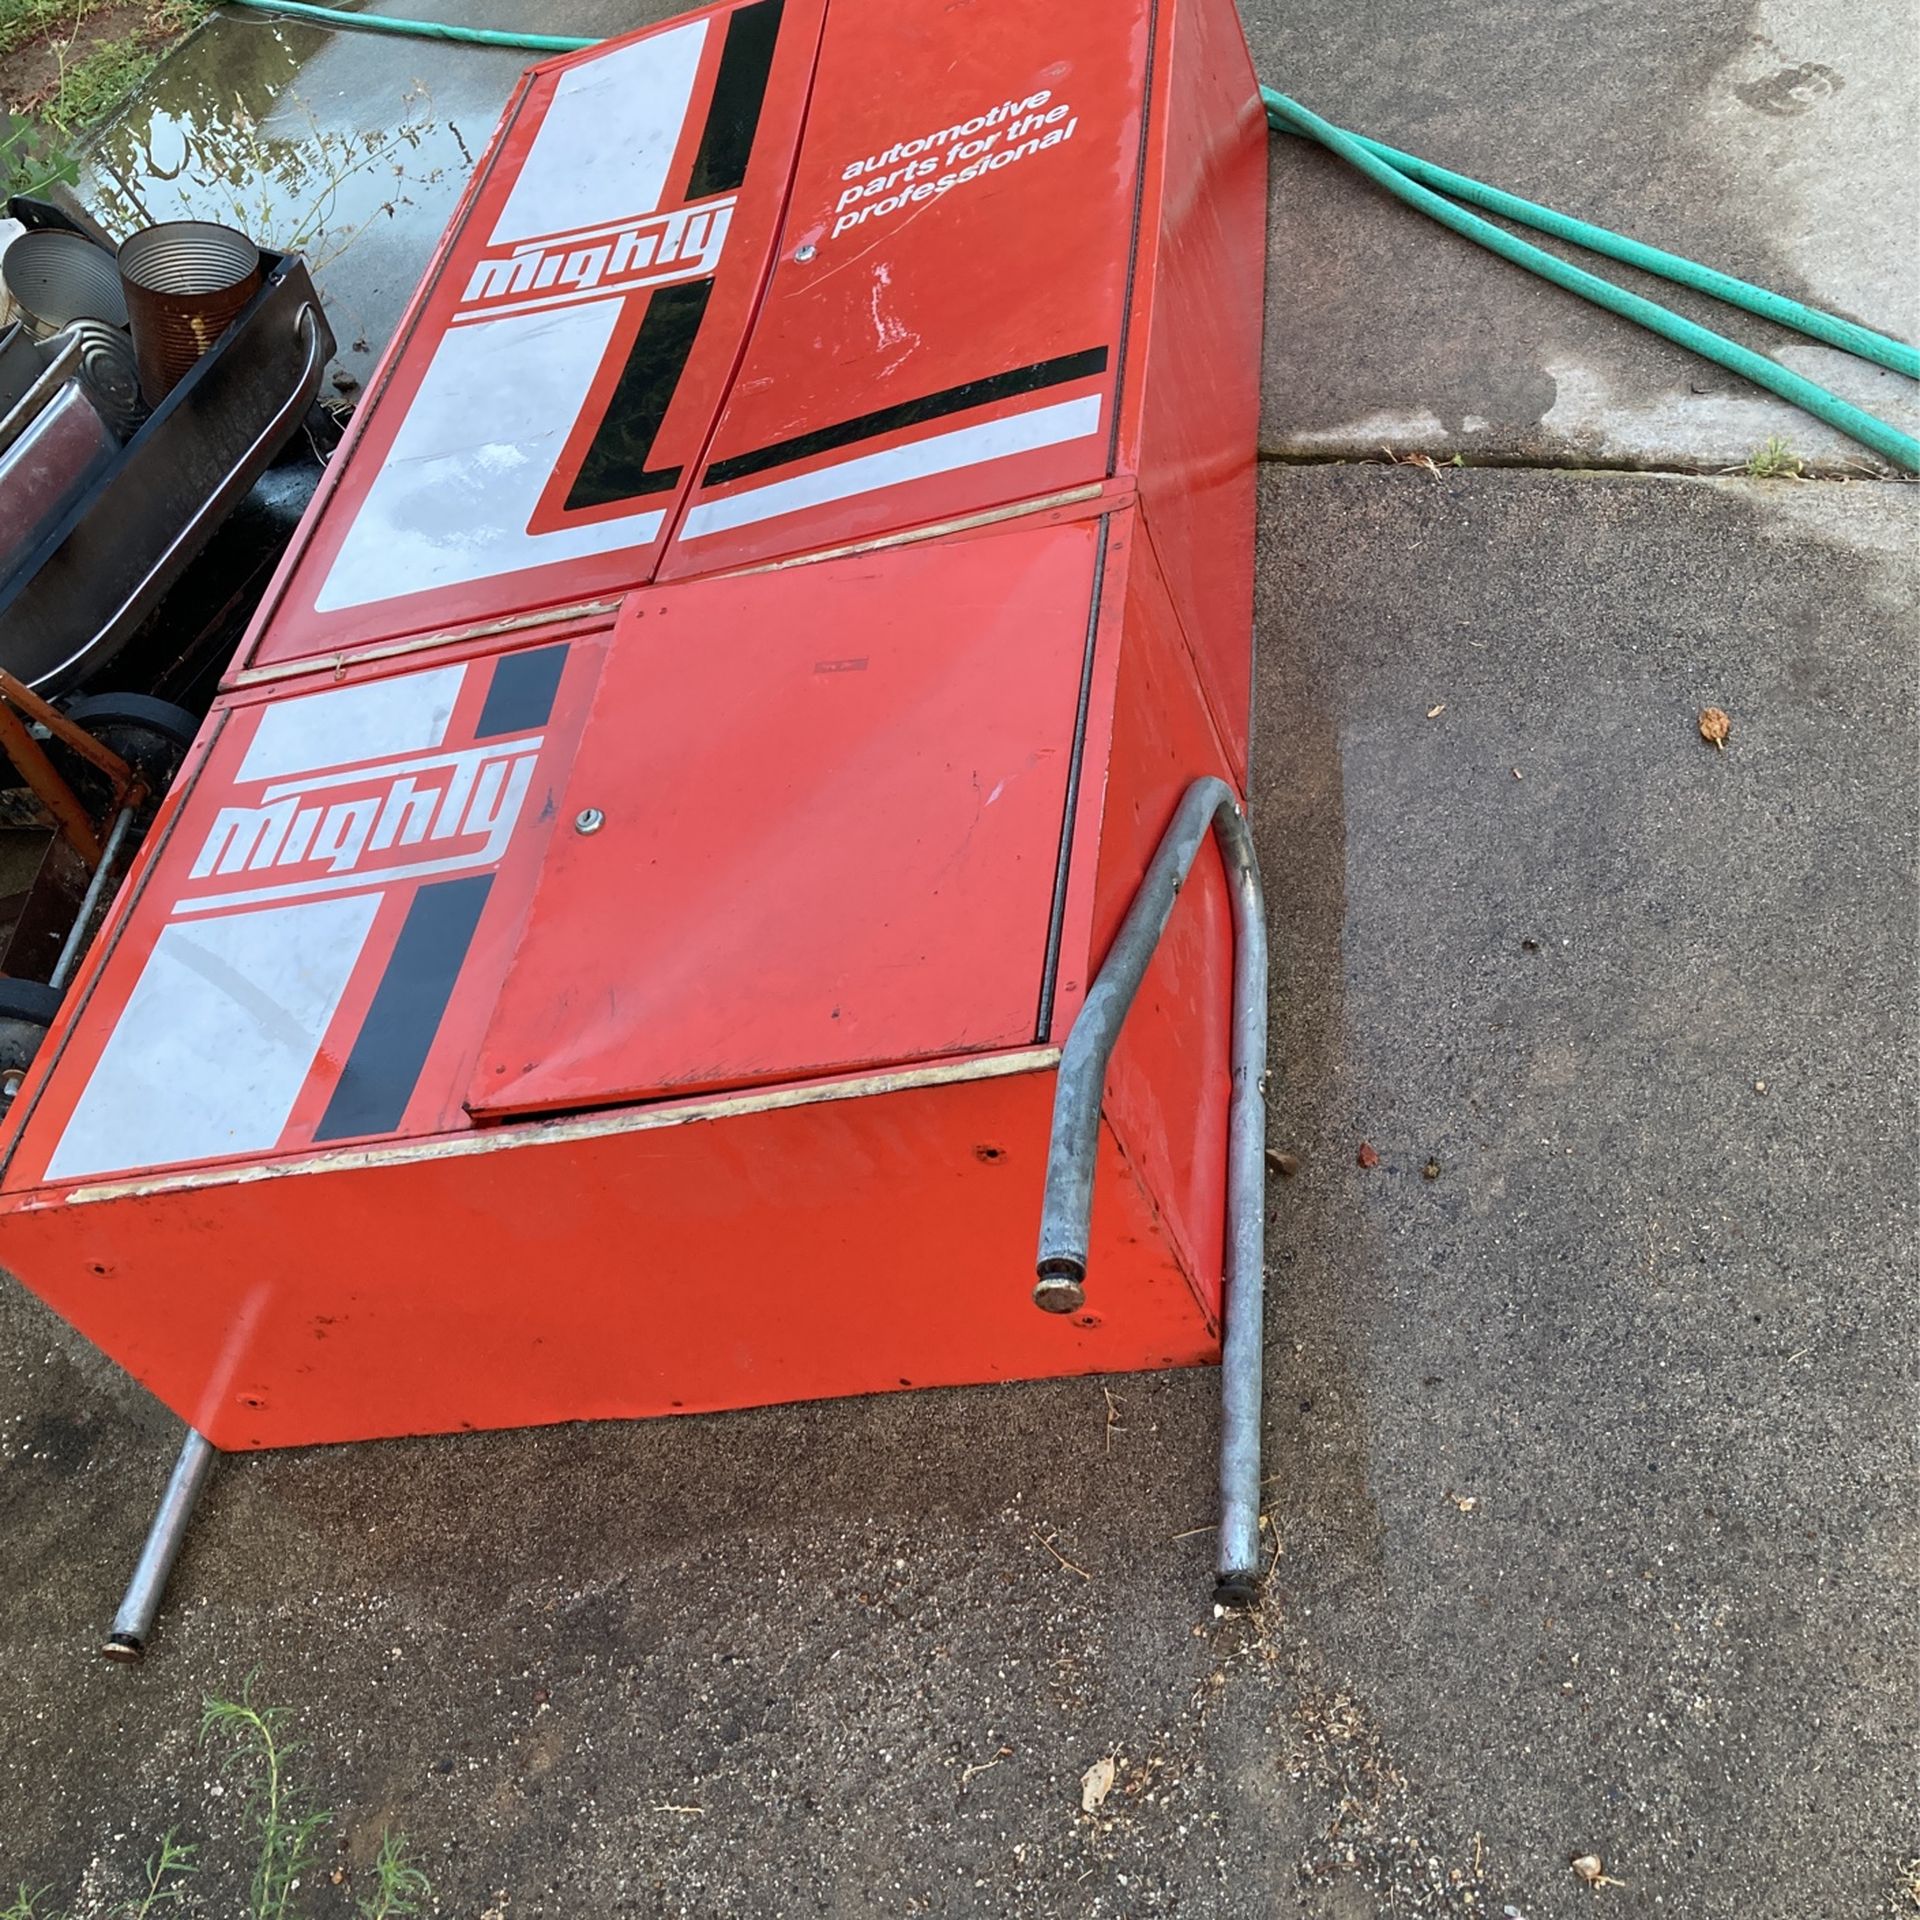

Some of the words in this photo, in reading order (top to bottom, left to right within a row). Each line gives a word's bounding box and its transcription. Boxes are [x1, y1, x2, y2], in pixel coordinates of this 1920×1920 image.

[830, 117, 1078, 239] professional
[835, 156, 939, 213] parts
[945, 131, 1001, 167] for
[1007, 104, 1070, 141] the
[841, 89, 1051, 180] automotive
